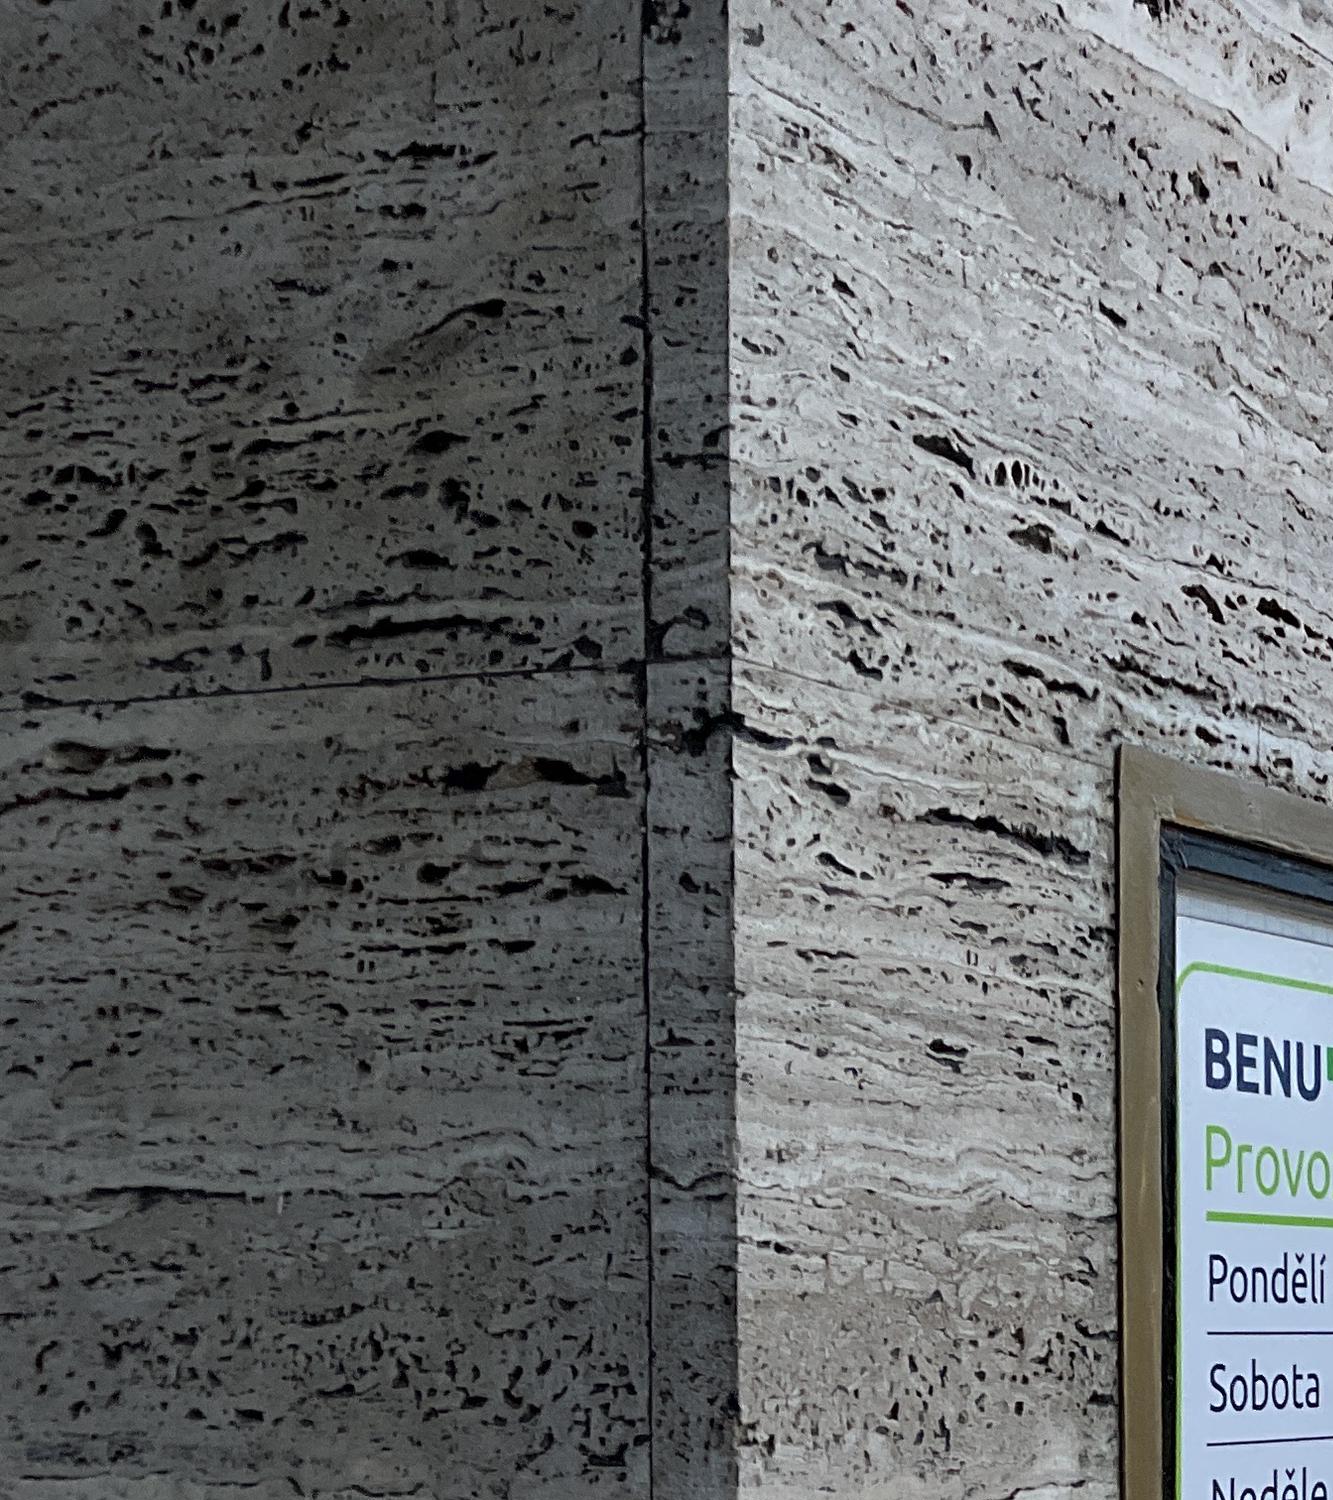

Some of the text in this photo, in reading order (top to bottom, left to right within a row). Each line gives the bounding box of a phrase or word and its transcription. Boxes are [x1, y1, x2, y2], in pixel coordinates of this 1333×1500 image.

[1204, 1028, 1322, 1102] BENU
[1208, 1252, 1326, 1305] Pondělí
[1208, 1358, 1322, 1414] Sobota
